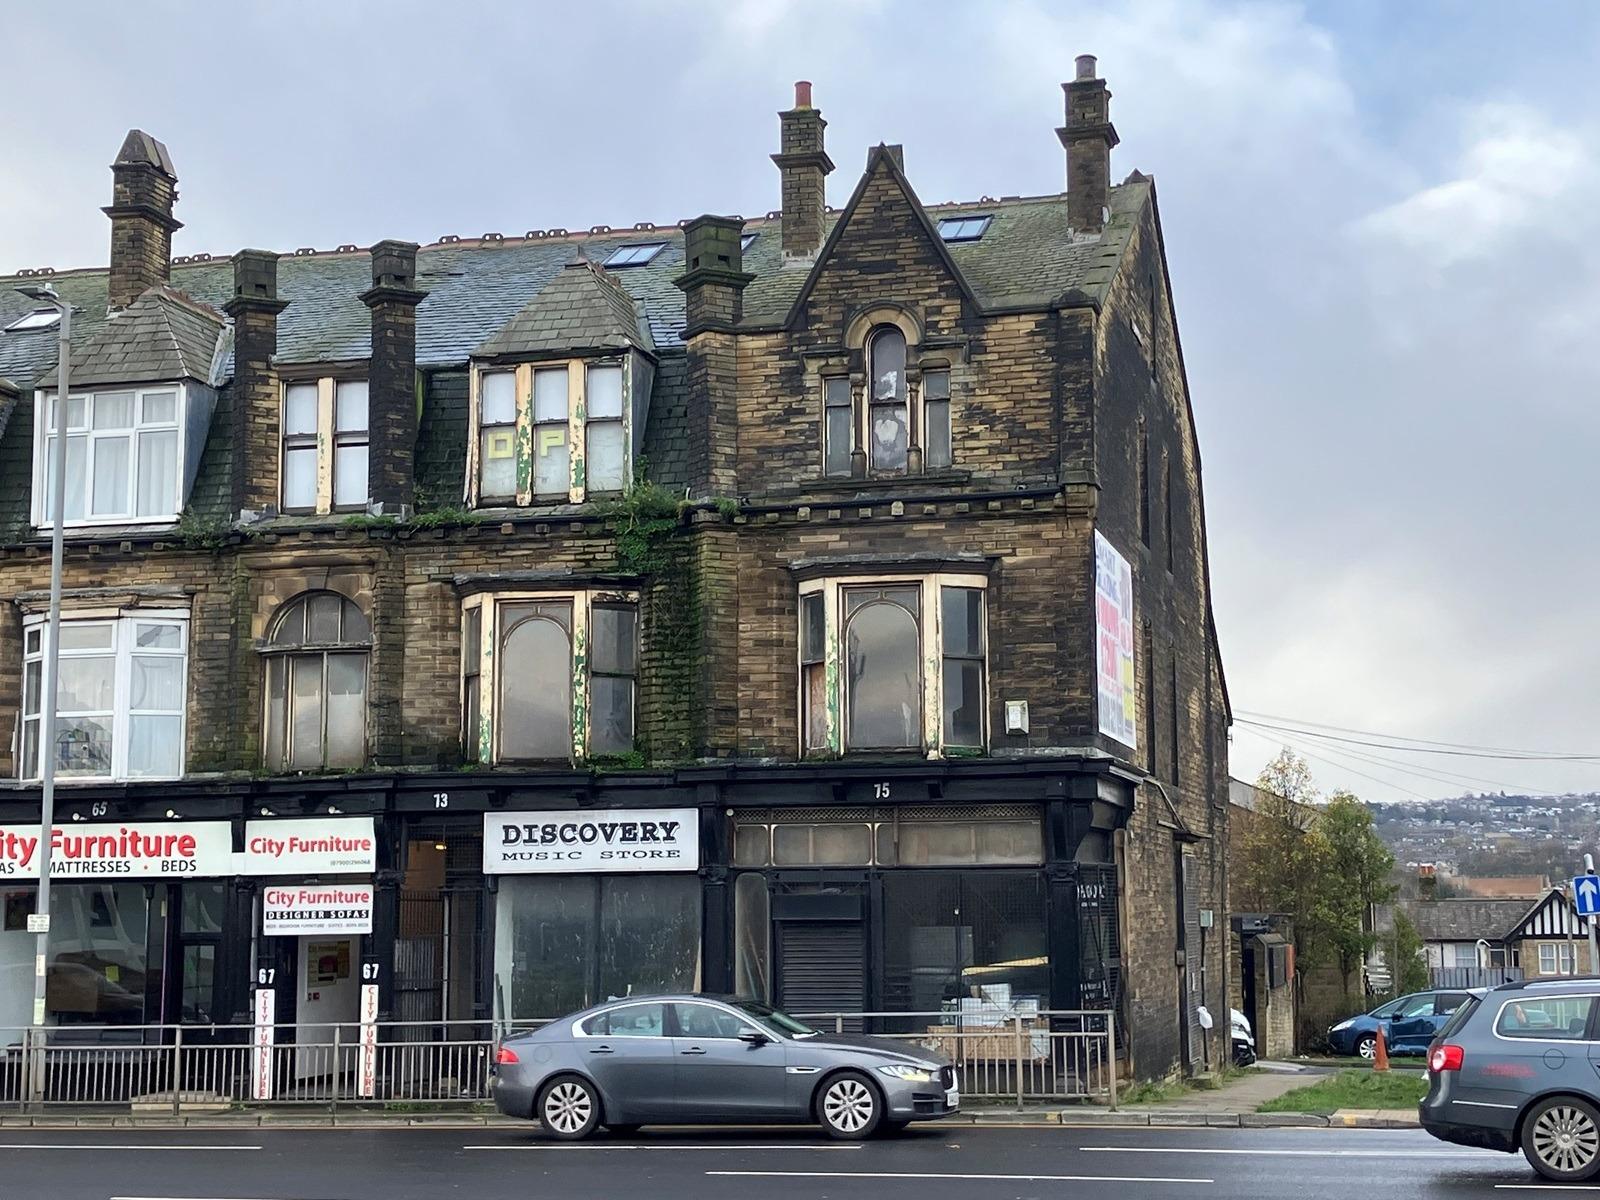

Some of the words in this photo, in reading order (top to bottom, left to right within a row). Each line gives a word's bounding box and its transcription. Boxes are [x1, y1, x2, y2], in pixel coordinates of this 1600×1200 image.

[874, 782, 890, 799] 75
[92, 801, 108, 817] 65
[502, 821, 680, 846] DISCOVERY
[49, 828, 196, 859] Furniture
[250, 837, 285, 858] City
[289, 836, 372, 854] Furniture
[502, 851, 583, 861] MUSIC
[599, 850, 680, 859] STORE
[161, 860, 197, 872] BEDS
[267, 891, 295, 908] City
[299, 890, 370, 905] Furniture
[268, 910, 325, 920] DESIGNER
[330, 909, 367, 919] SOFAS
[258, 968, 275, 984] 67
[362, 963, 379, 979] 67
[261, 991, 269, 1021] CITY
[367, 986, 375, 1018] CITY
